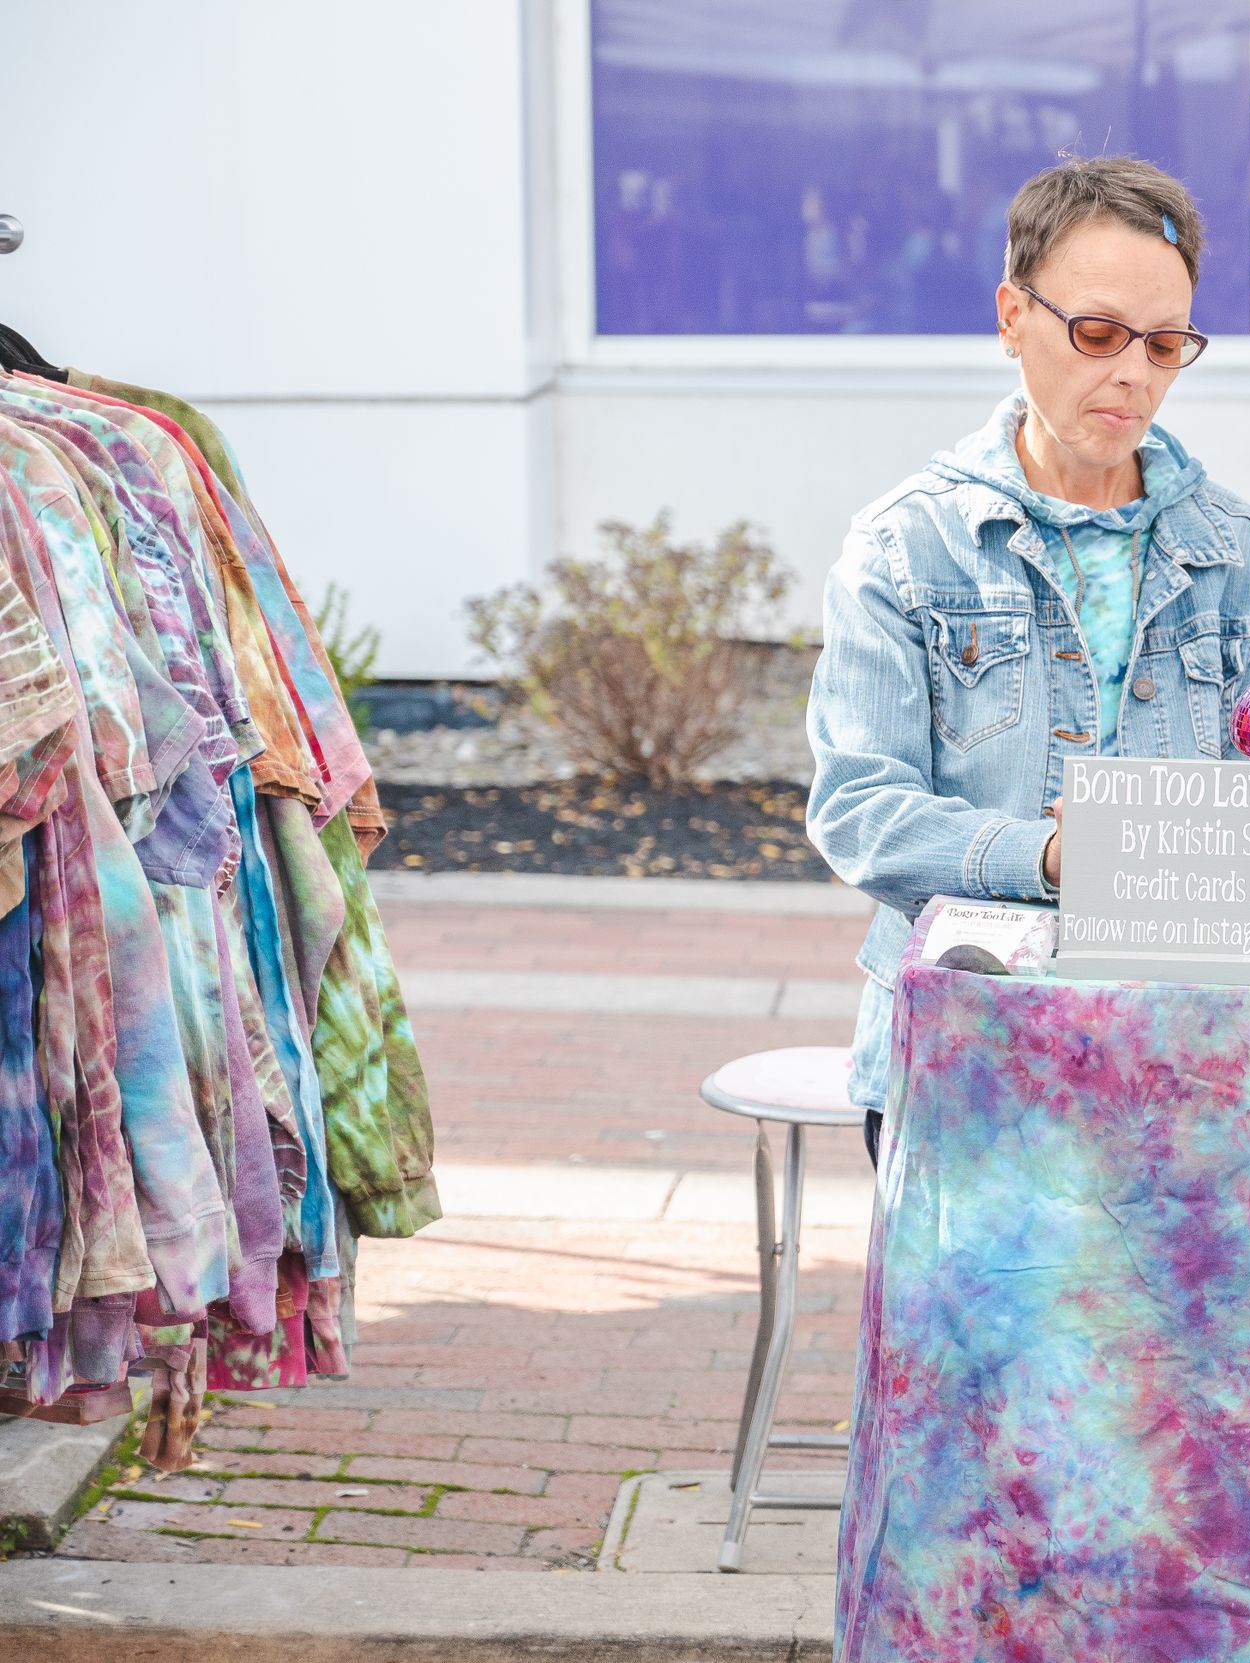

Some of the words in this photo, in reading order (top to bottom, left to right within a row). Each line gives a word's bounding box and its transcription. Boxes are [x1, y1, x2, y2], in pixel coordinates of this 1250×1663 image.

[1072, 763, 1144, 805] Born
[1149, 765, 1205, 807] Too
[1120, 819, 1152, 859] By
[1157, 817, 1236, 856] Kristin
[1113, 868, 1180, 901] Credit
[1185, 870, 1246, 903] Cards
[1063, 913, 1127, 942] Follow
[1130, 920, 1158, 944] me
[1162, 920, 1188, 945] on
